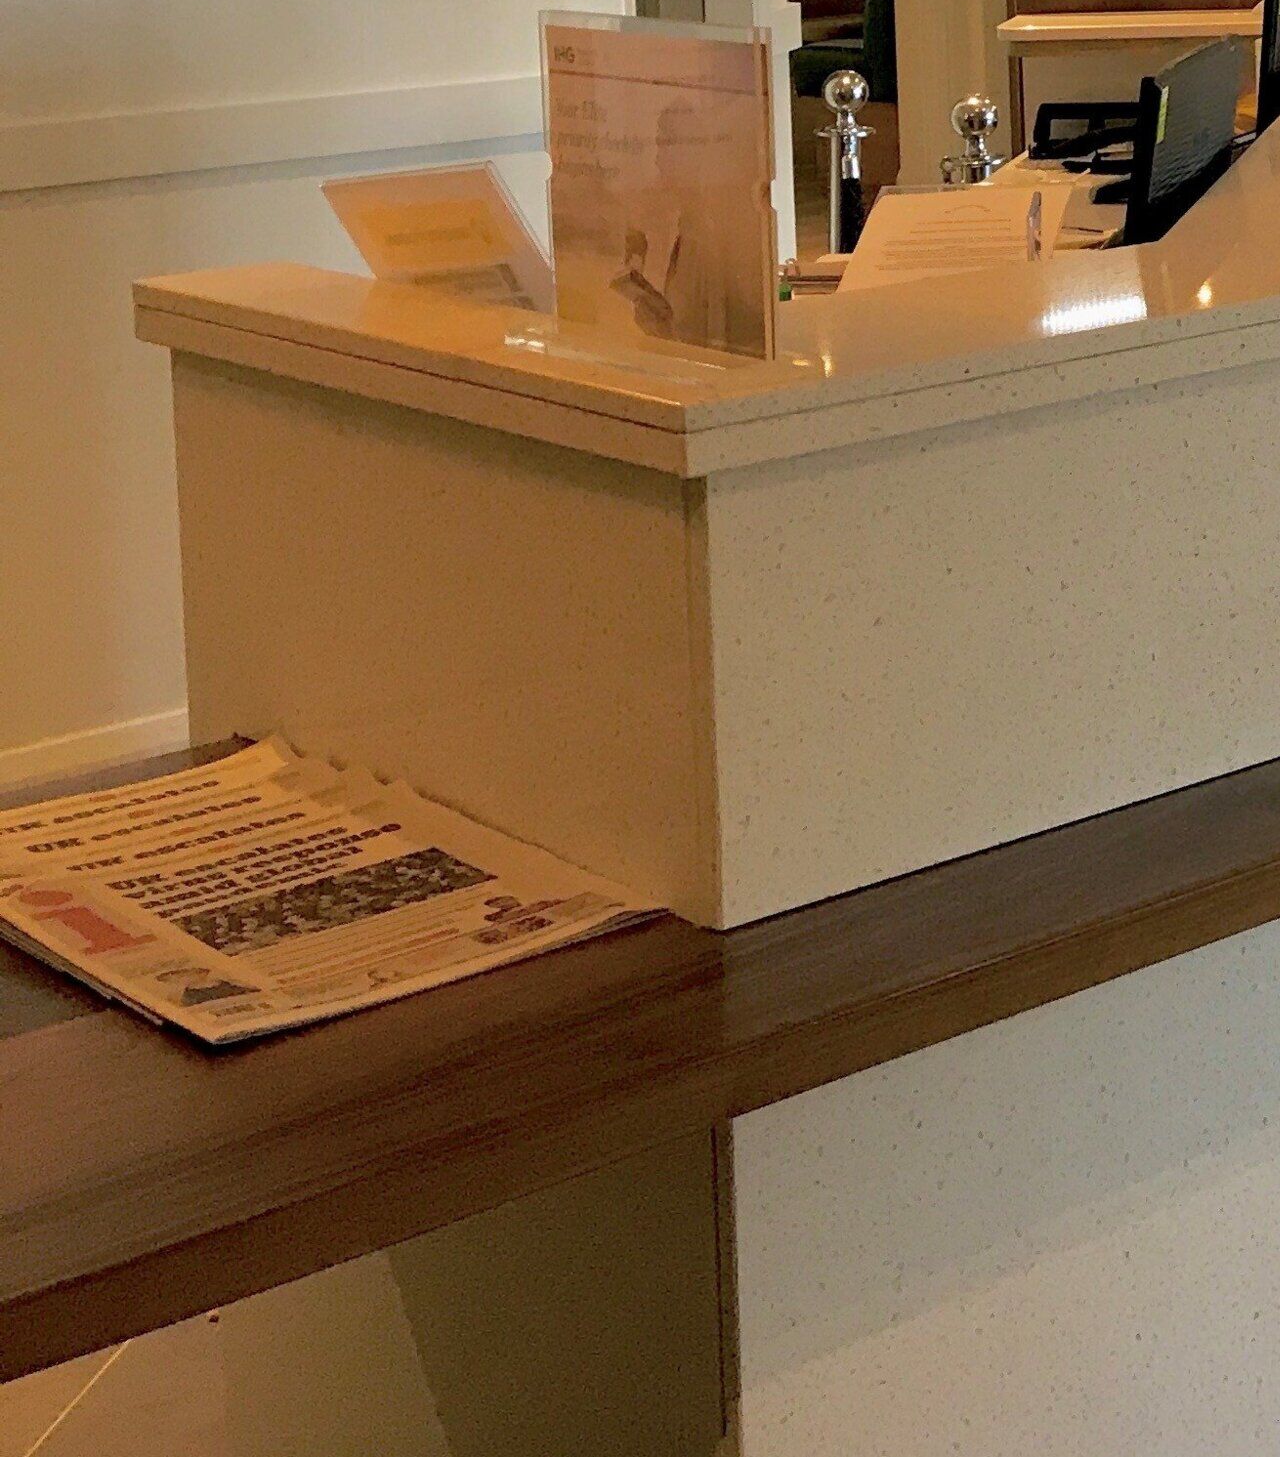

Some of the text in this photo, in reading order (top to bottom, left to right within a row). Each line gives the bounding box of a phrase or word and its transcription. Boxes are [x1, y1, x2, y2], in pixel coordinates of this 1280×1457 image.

[90, 795, 263, 841] escalates
[133, 812, 306, 860] escalates
[105, 826, 348, 891] UK escalates
[230, 823, 401, 875] response
[244, 846, 364, 884] global
